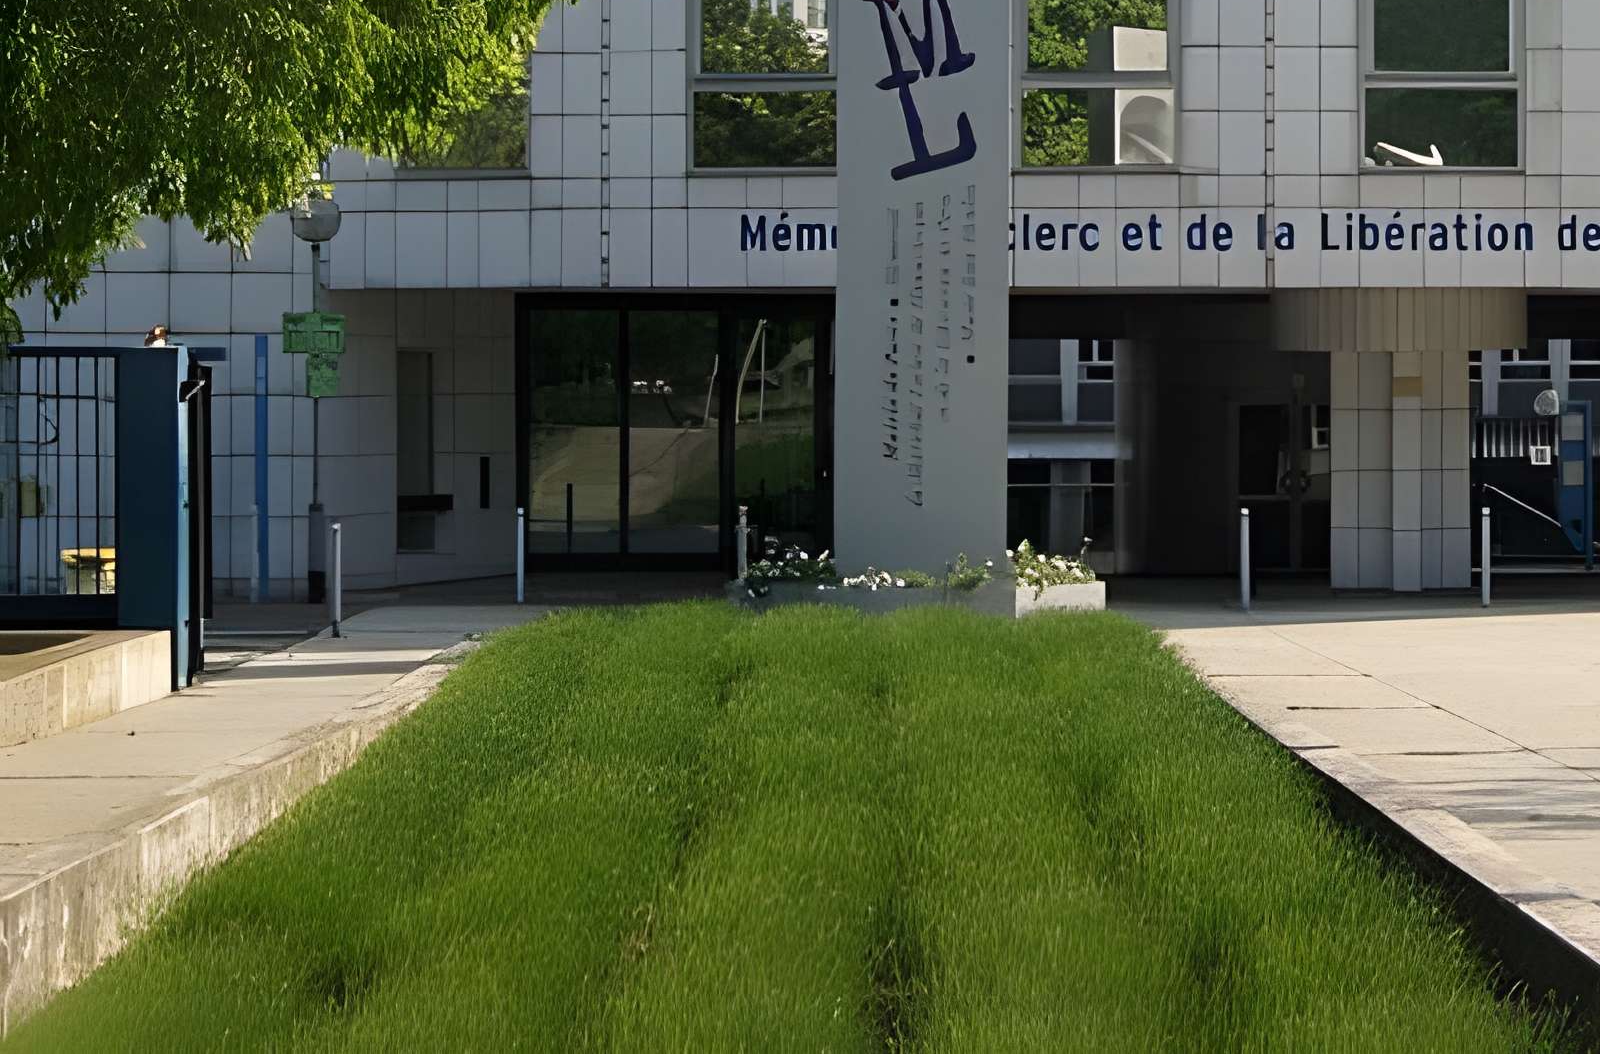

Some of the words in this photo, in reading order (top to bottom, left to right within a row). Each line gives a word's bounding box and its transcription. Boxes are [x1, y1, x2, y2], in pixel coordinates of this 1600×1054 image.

[1122, 213, 1163, 252] et
[1186, 213, 1233, 252] de
[1257, 213, 1295, 251] la
[1320, 211, 1533, 252] Libération
